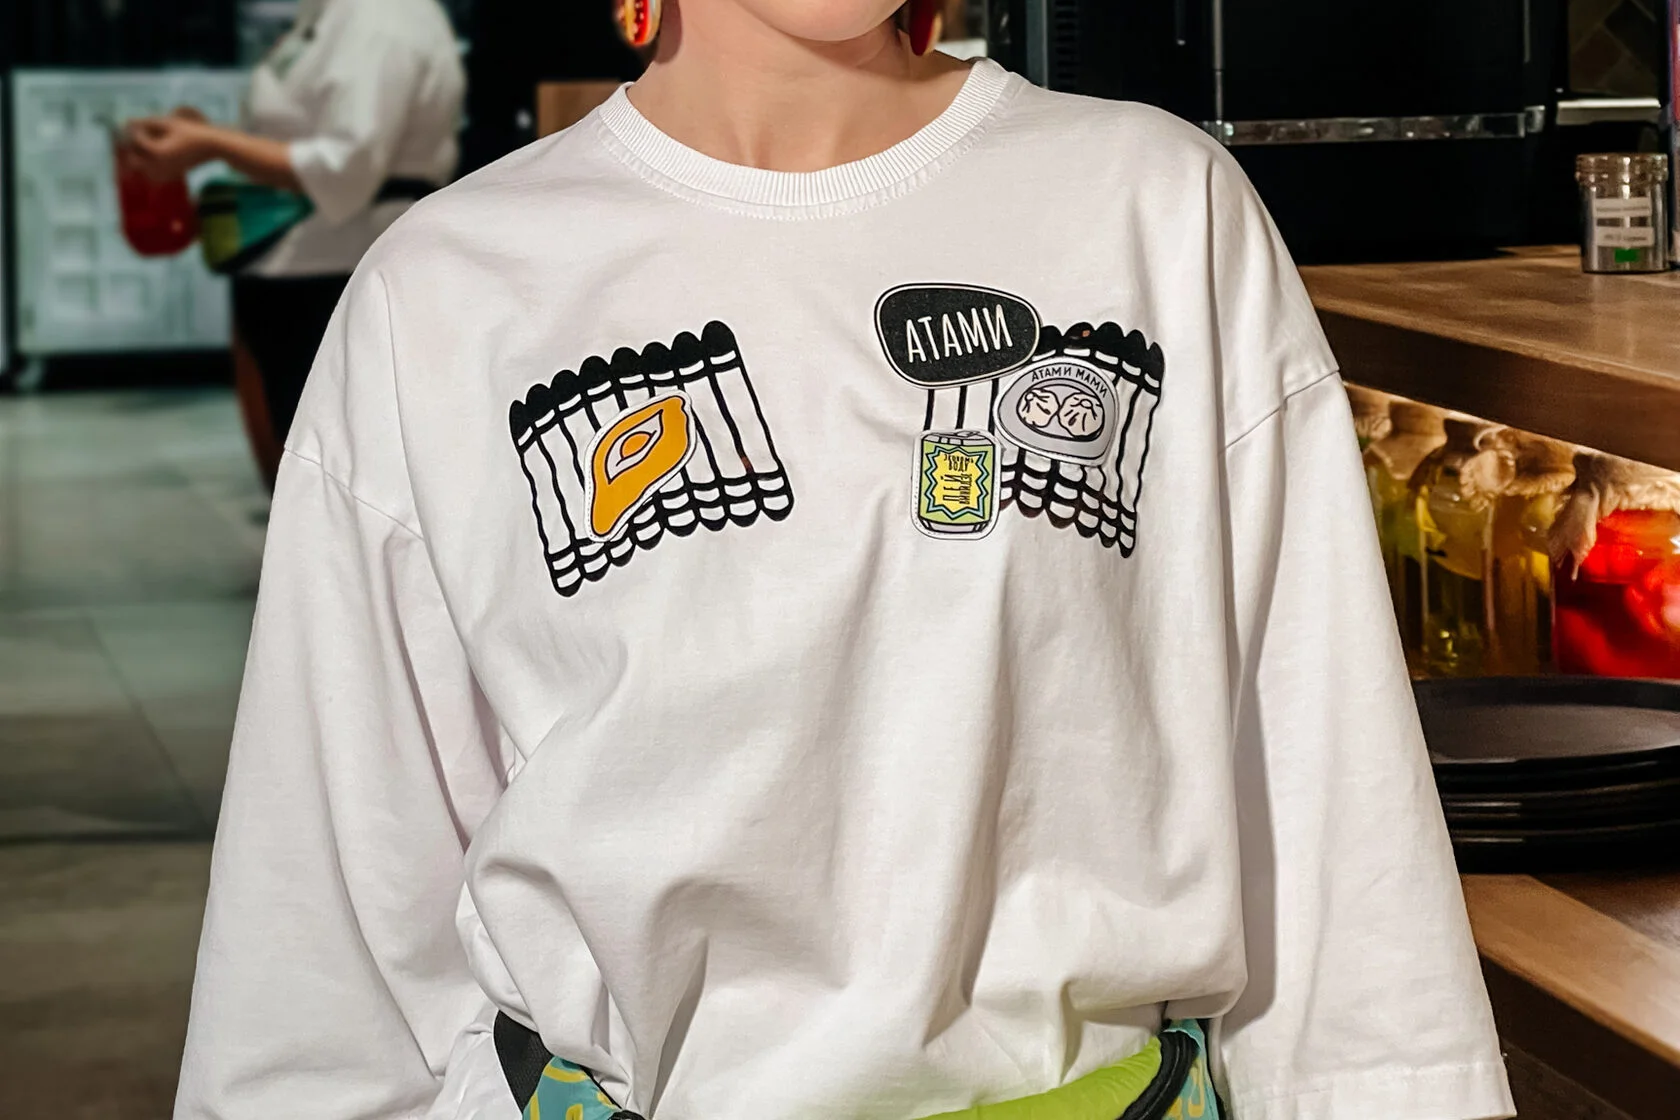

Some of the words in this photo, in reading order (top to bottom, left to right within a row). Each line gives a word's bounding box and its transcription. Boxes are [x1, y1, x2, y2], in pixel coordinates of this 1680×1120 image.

[907, 304, 1013, 363] АТАМИ
[1031, 366, 1072, 382] АТАМИ
[1075, 368, 1108, 398] МАМИ
